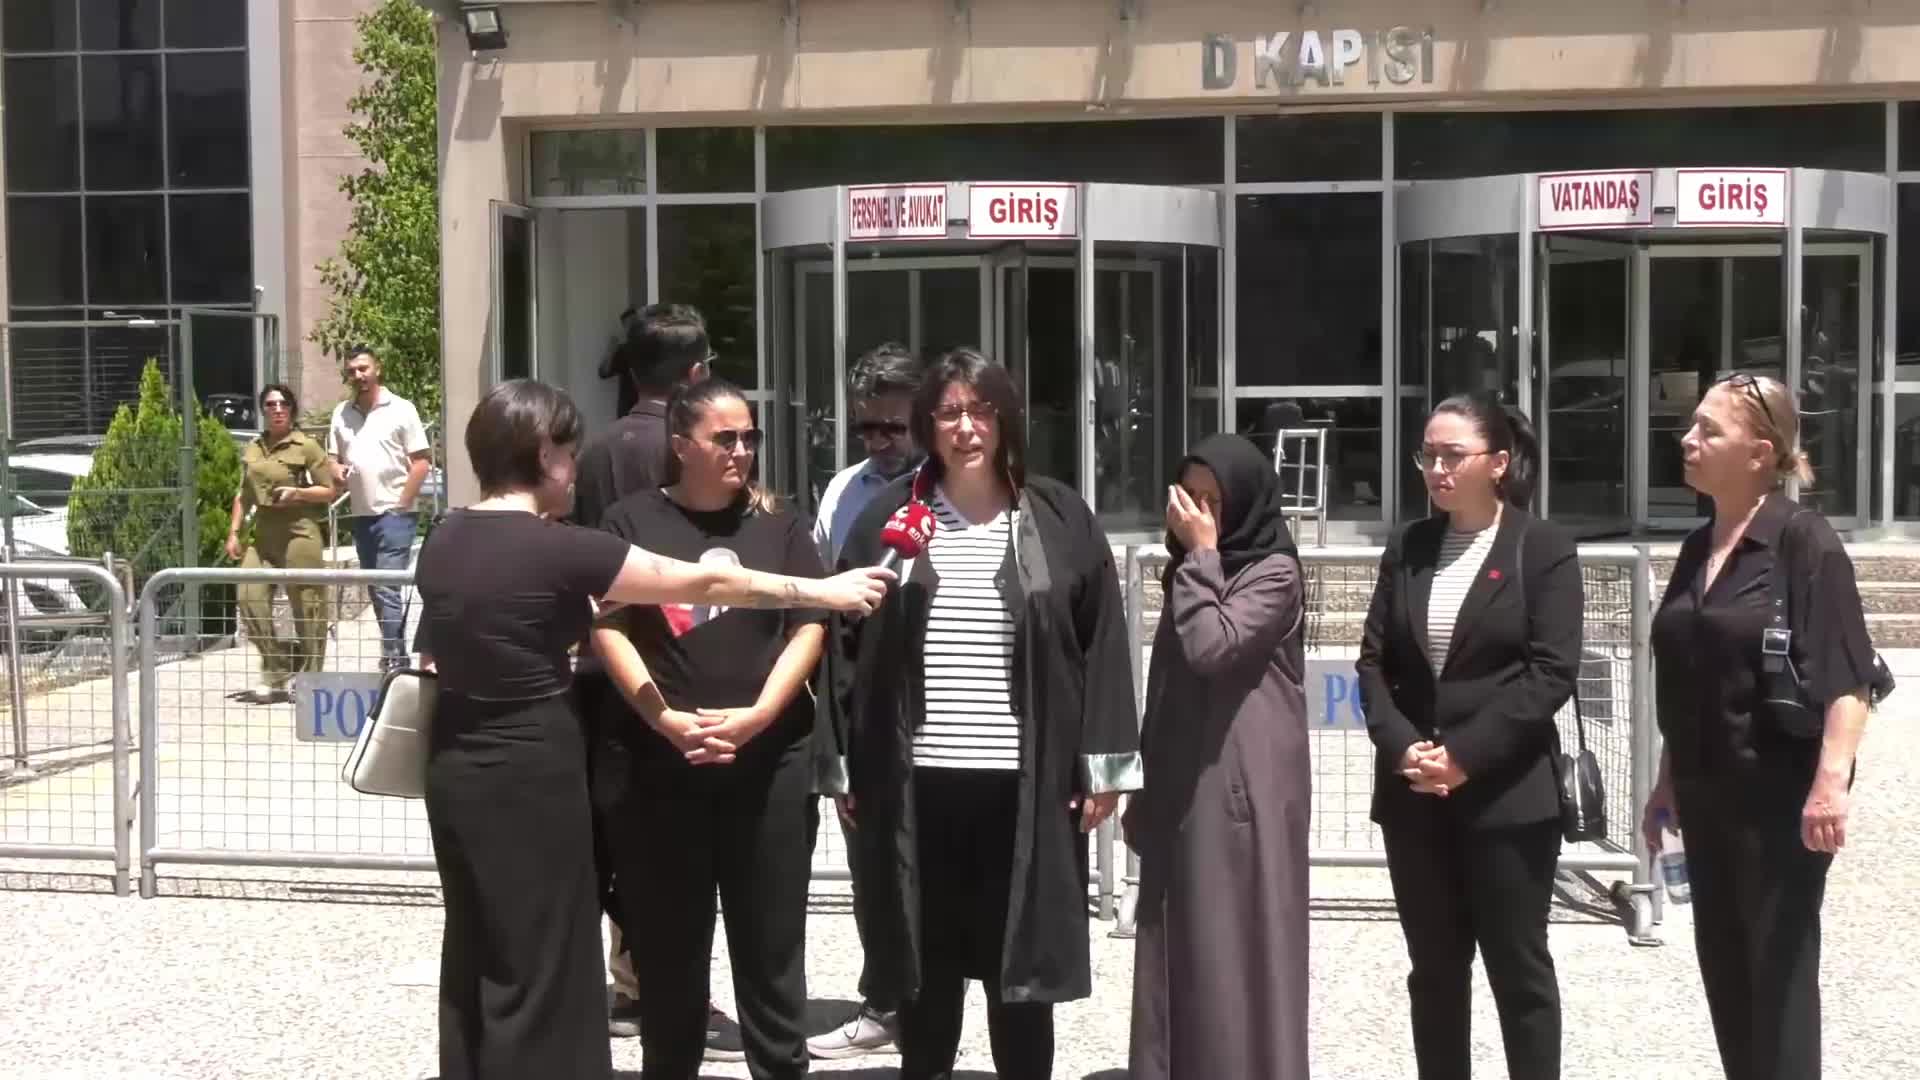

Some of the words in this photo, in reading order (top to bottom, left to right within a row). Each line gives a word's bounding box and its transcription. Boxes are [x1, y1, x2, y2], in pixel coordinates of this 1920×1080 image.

[1202, 32, 1237, 89] D
[1255, 26, 1434, 88] KAPISI
[852, 197, 893, 230] PERSONEL
[895, 196, 906, 228] VE
[908, 194, 943, 228] AVUKAT
[989, 192, 1058, 230] GİRİŞ
[1551, 179, 1640, 216] VATANDAŞ
[1698, 177, 1768, 217] GİRİŞ
